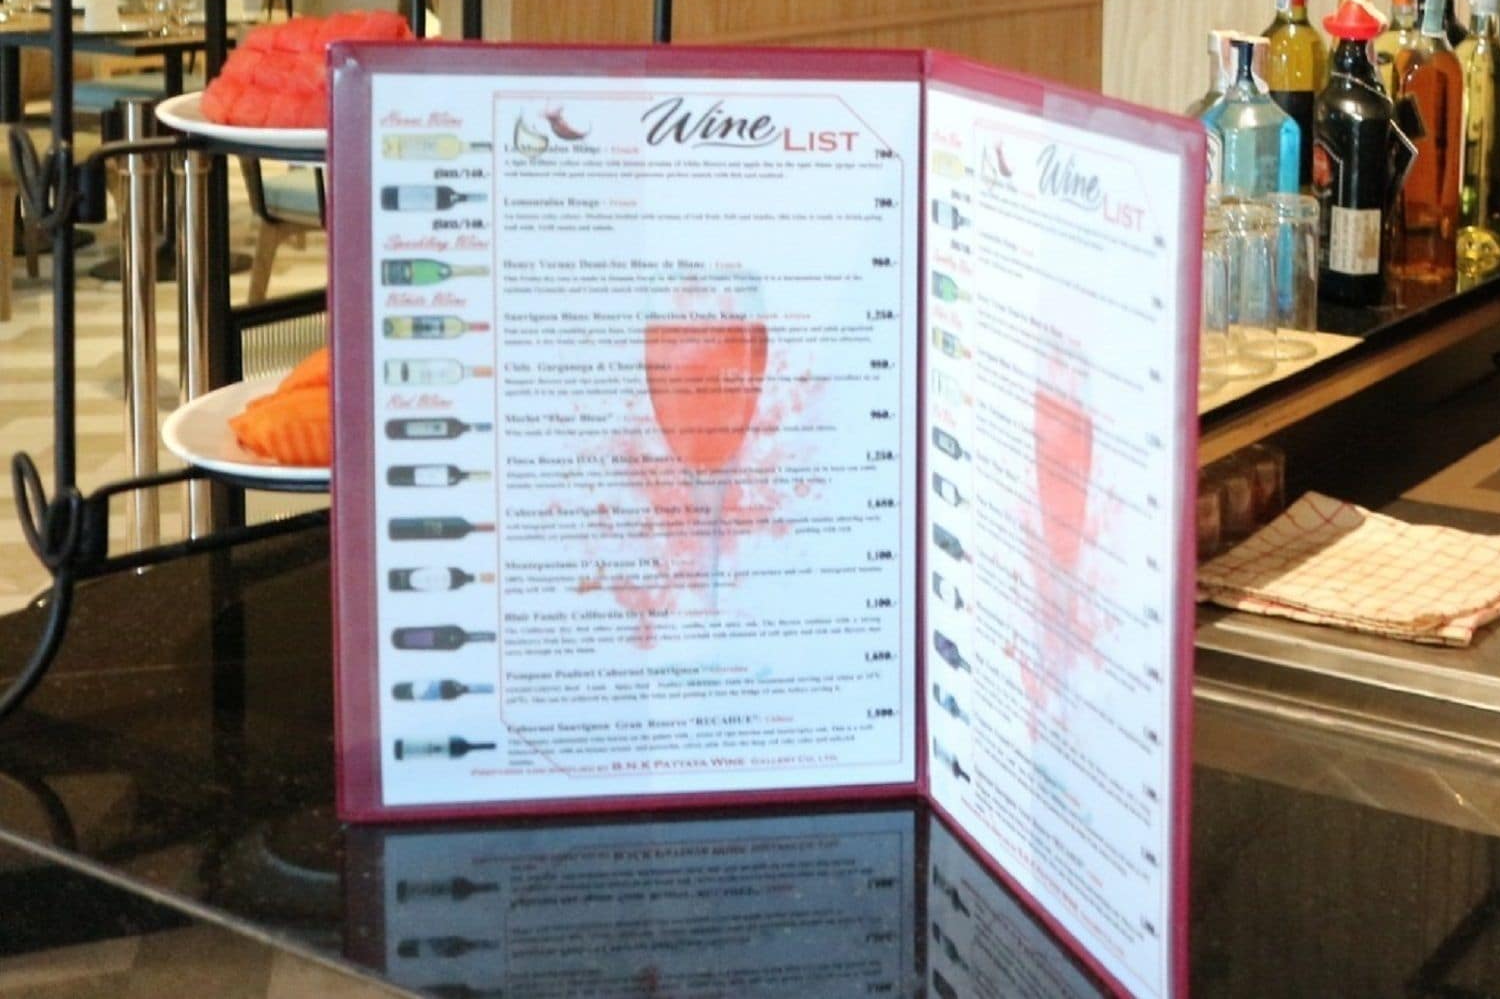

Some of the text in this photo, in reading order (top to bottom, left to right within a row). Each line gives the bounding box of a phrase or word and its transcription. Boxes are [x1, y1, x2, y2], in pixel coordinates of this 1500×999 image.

[641, 97, 860, 152] Wine LIST
[1036, 143, 1145, 233] Wine LIST
